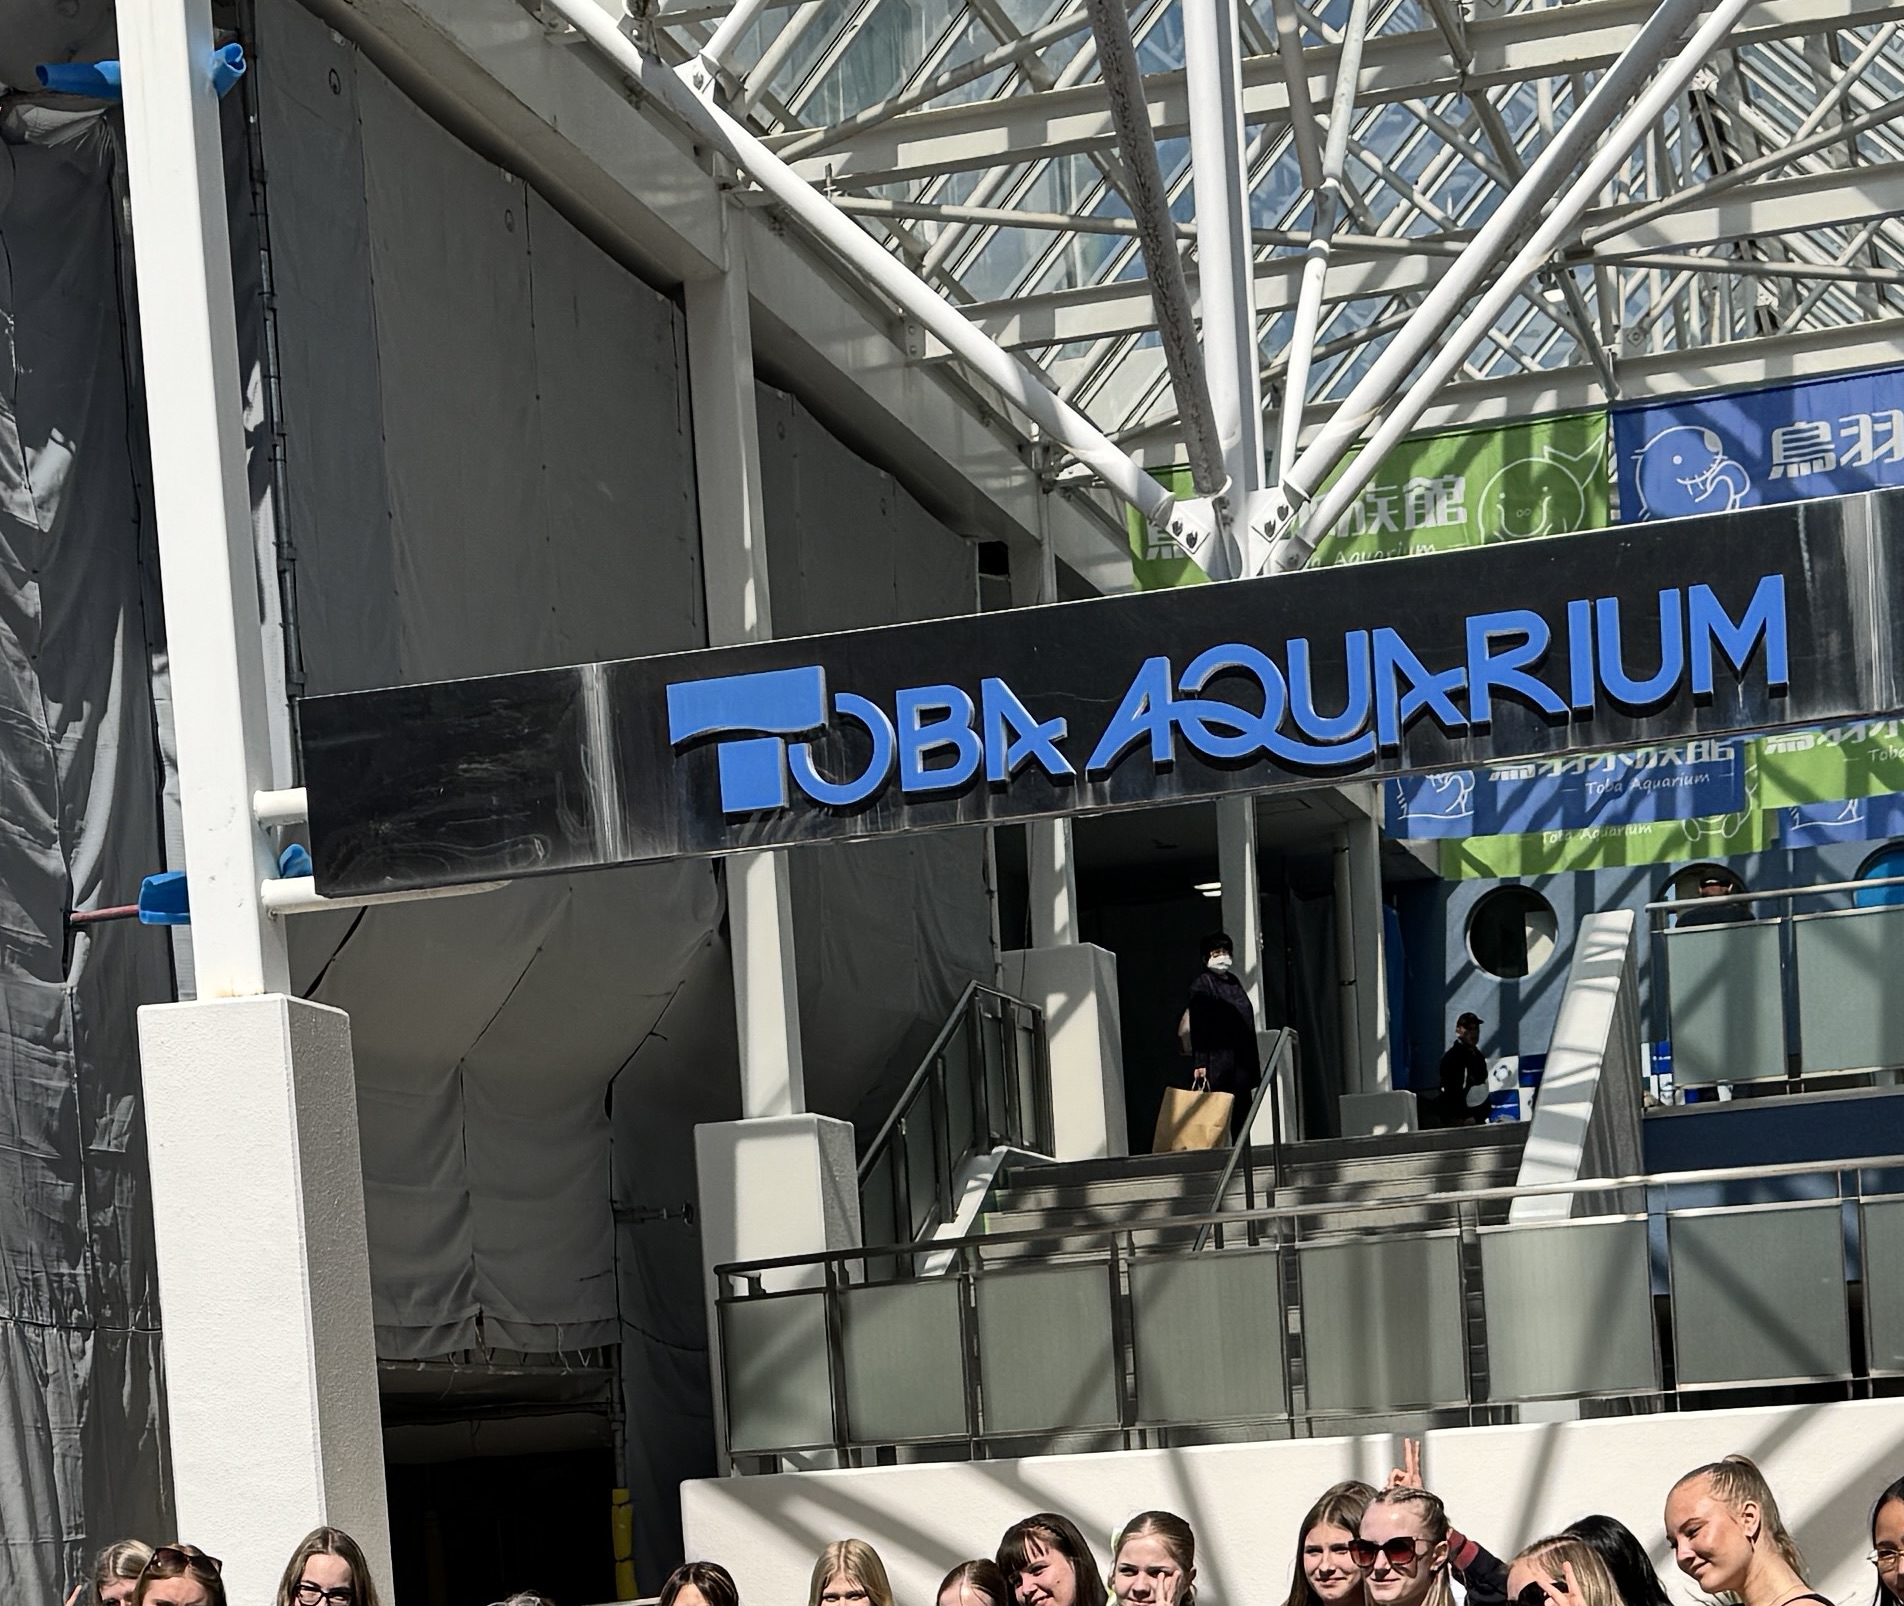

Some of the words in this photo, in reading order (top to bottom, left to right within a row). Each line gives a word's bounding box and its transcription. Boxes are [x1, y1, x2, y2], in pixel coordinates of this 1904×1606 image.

[665, 662, 1078, 814] TOBA
[1084, 572, 1789, 774] AQUARIUM
[1585, 778, 1623, 796] Toba
[1631, 772, 1711, 794] Aquarium
